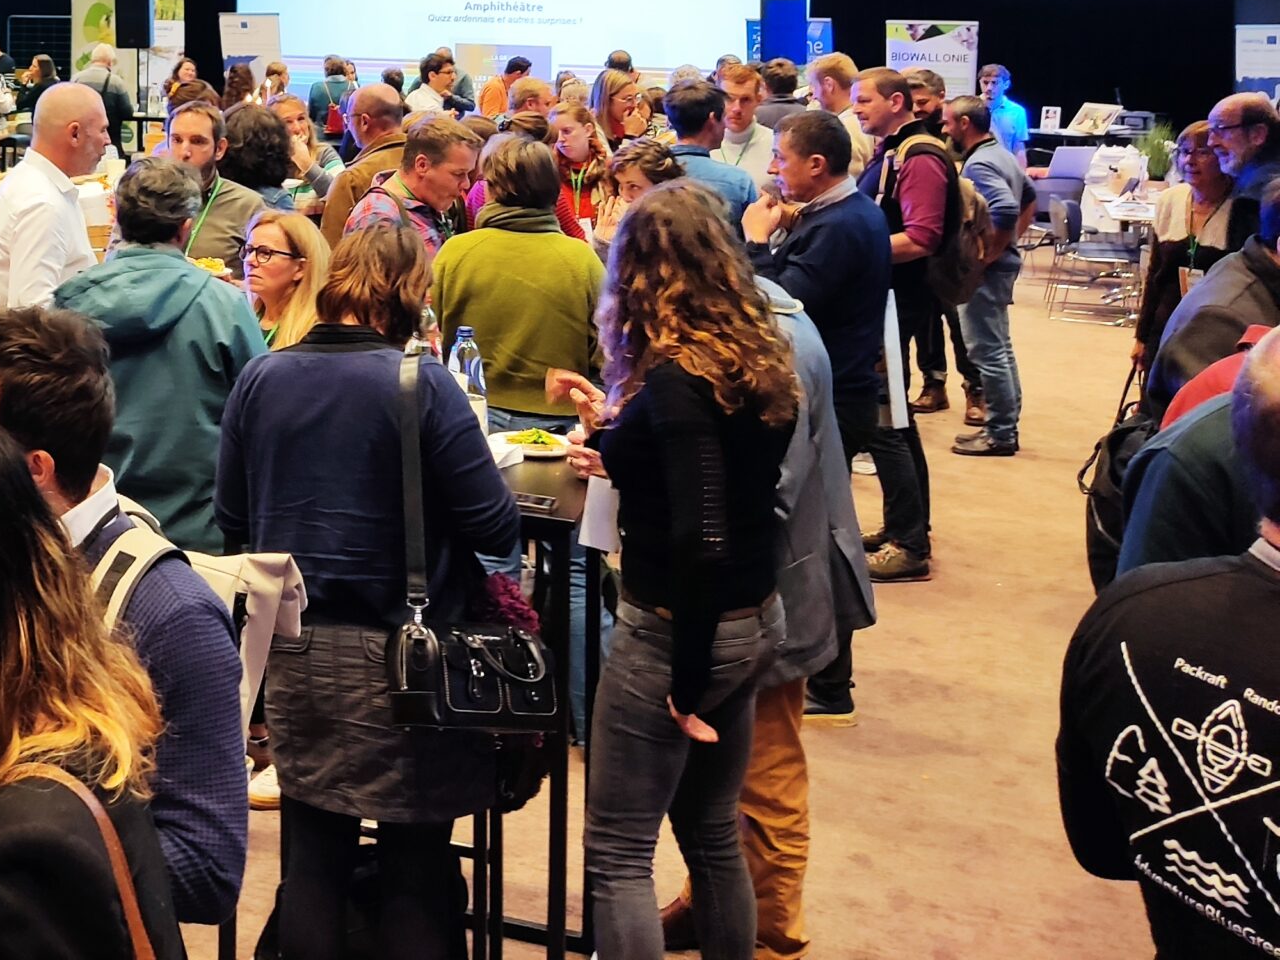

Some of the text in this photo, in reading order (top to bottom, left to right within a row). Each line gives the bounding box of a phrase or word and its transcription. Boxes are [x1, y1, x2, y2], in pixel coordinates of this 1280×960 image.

[453, 14, 496, 23] ardennais
[507, 15, 535, 24] autres
[891, 52, 969, 63] BIOWALLONIE
[1173, 657, 1228, 689] Packraft
